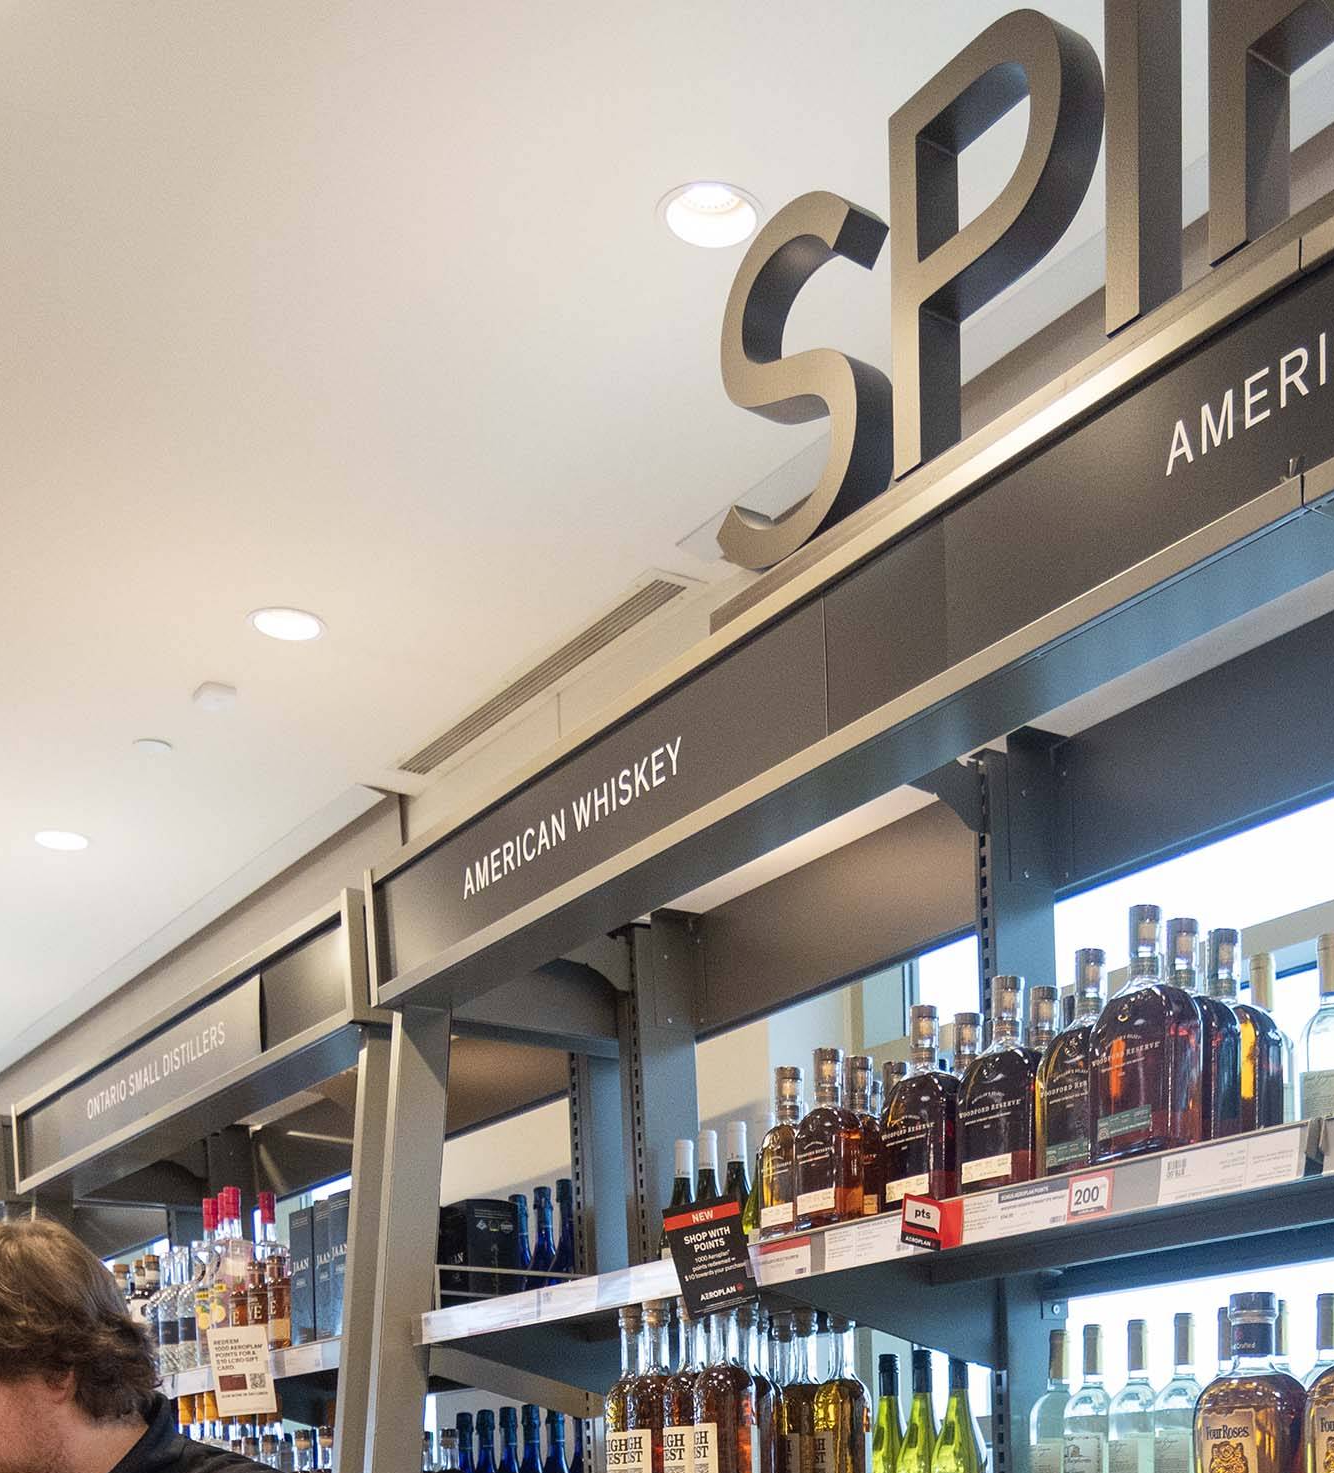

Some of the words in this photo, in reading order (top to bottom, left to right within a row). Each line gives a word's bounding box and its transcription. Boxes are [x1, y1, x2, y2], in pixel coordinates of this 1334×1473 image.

[463, 808, 566, 900] AMERICAN
[572, 736, 682, 832] WHISKEY
[87, 1079, 127, 1120] ONTARIO
[128, 1061, 161, 1097] SMALL
[162, 1021, 226, 1077] DISTILLERS
[1073, 1185, 1099, 1206] 200
[692, 1210, 713, 1224] NEW
[914, 1207, 931, 1220] pts
[683, 1231, 708, 1245] SHOP
[707, 1226, 731, 1239] WITH
[694, 1238, 725, 1252] POINTS
[700, 1285, 736, 1301] AEROPLAN
